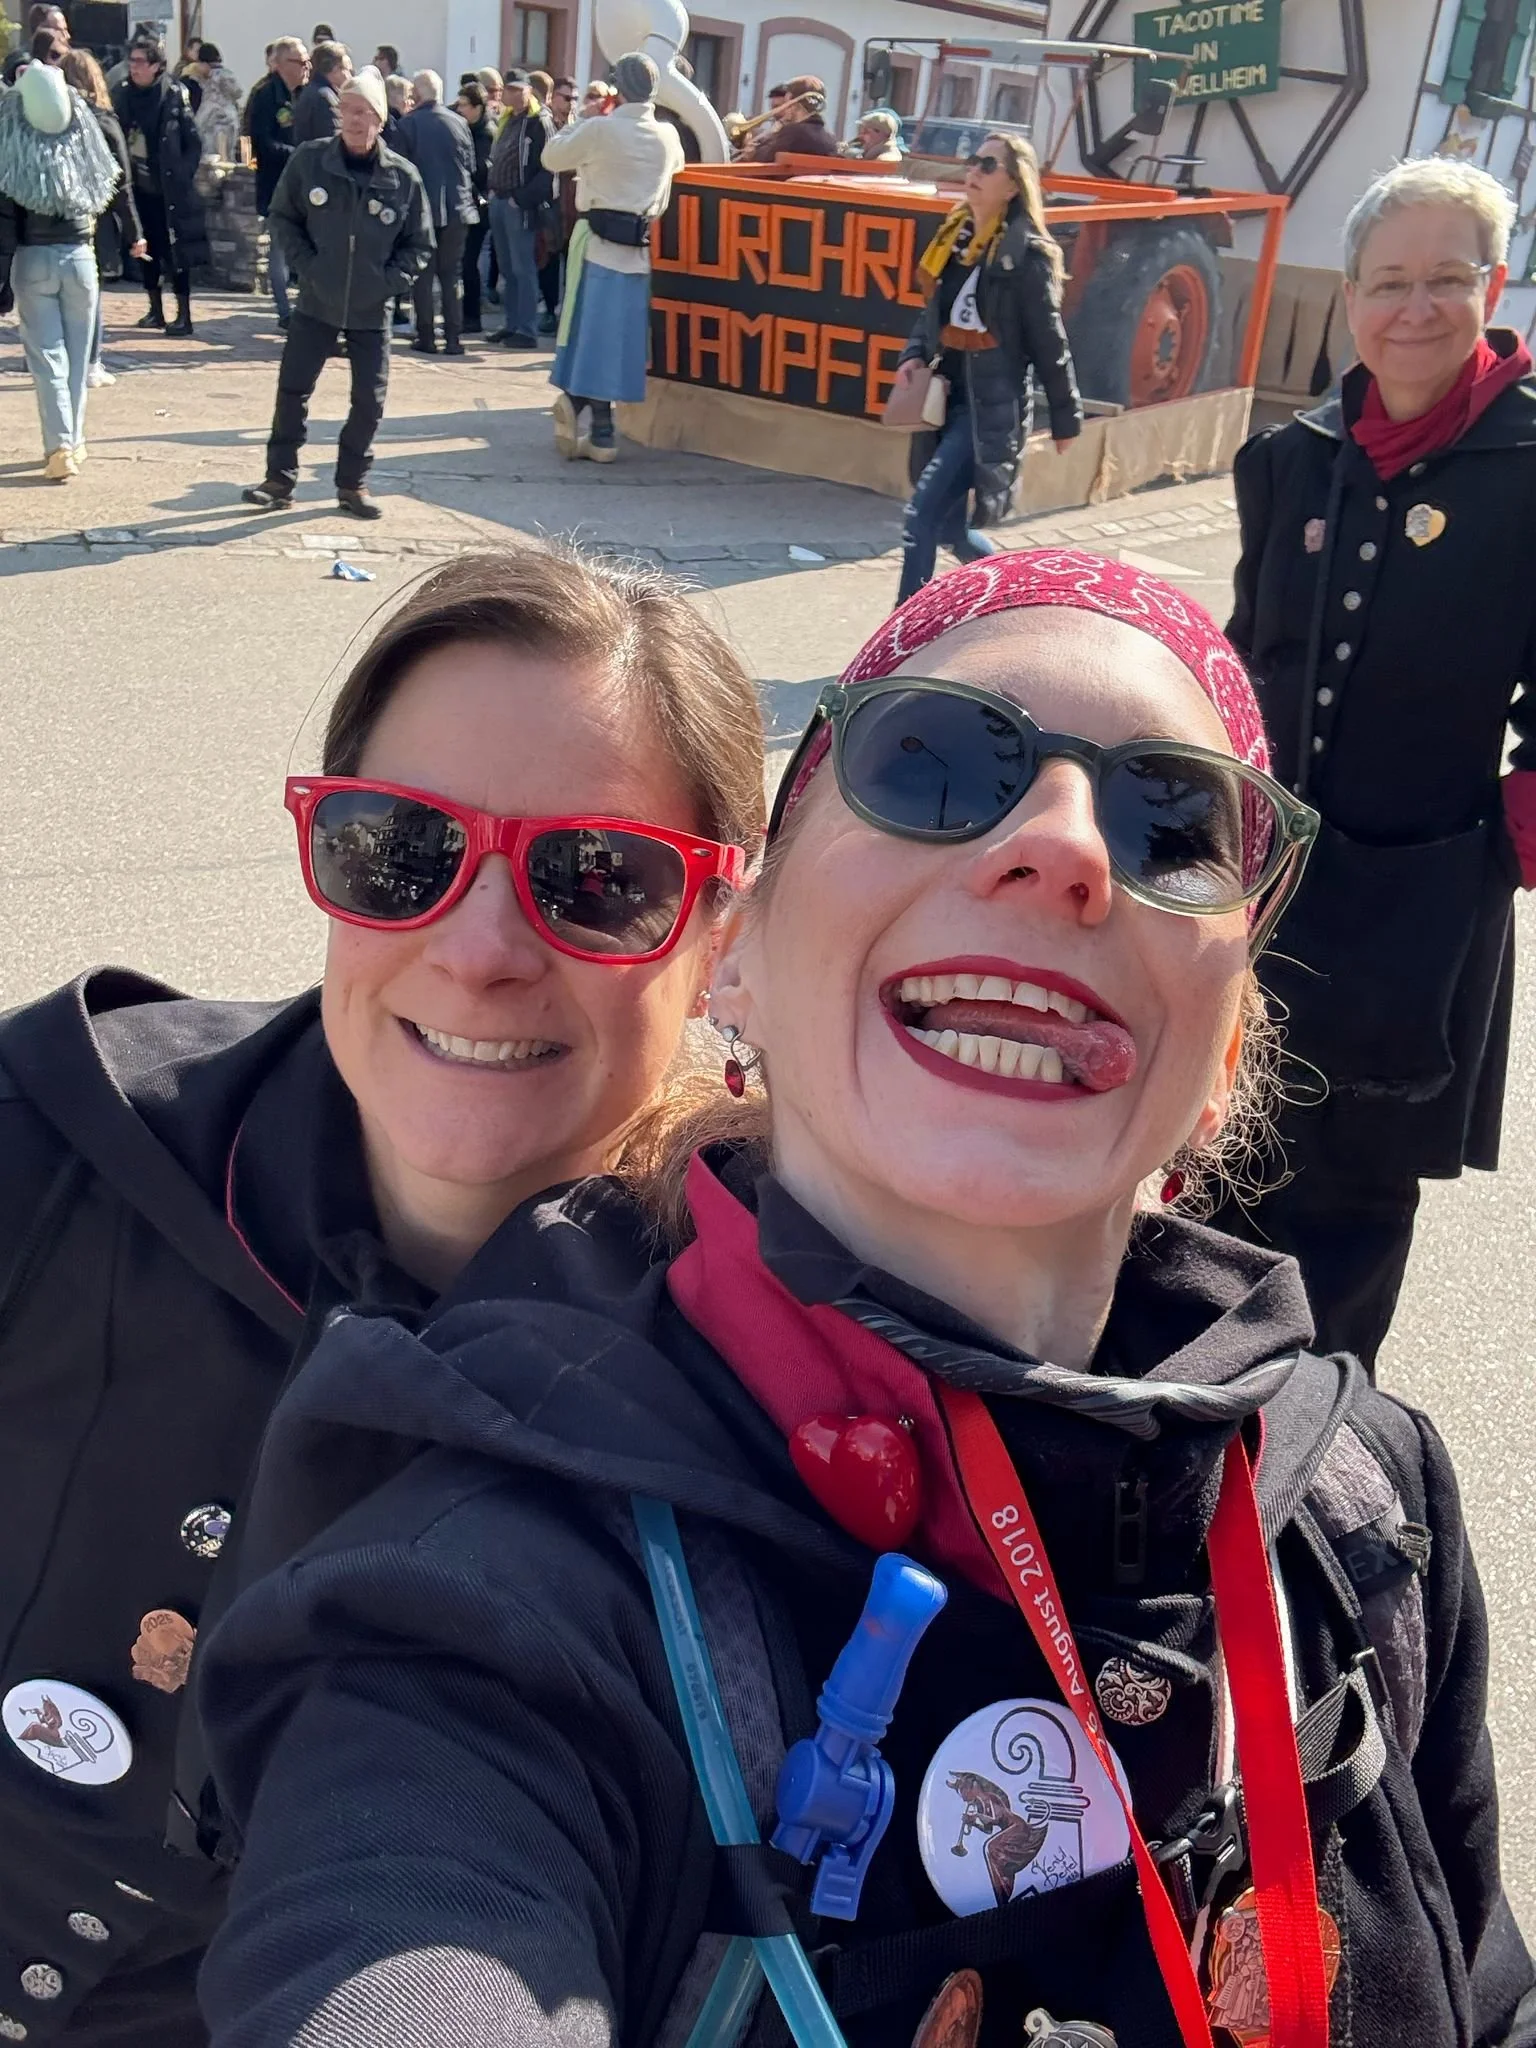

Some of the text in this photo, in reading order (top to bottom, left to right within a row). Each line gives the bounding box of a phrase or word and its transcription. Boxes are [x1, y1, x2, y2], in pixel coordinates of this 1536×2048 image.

[1191, 40, 1218, 64] IN
[992, 1504, 1043, 1586] 2018
[1033, 1586, 1085, 1696] August
